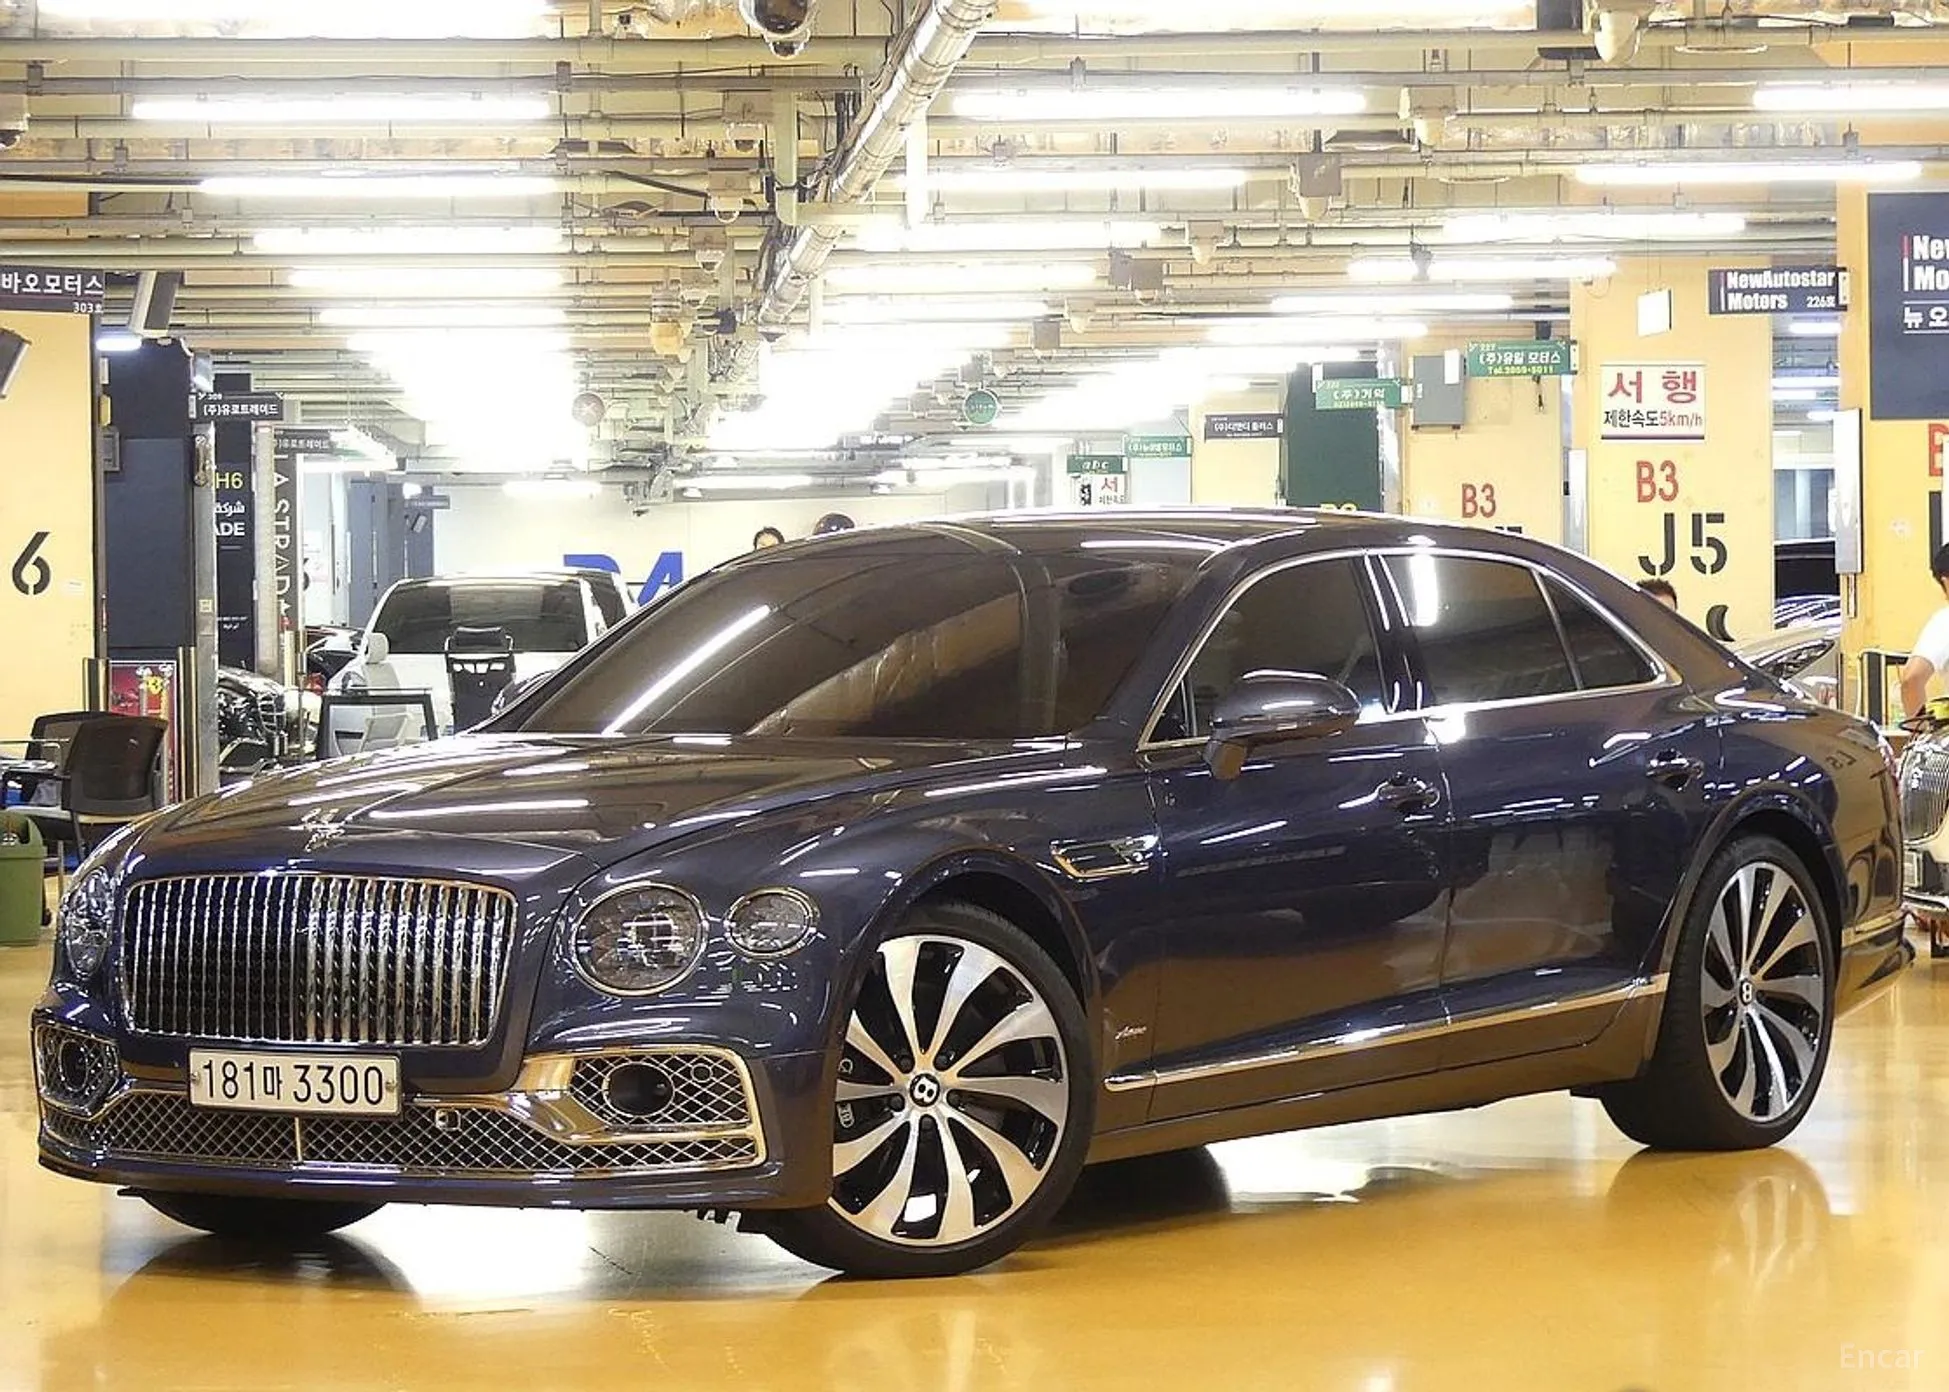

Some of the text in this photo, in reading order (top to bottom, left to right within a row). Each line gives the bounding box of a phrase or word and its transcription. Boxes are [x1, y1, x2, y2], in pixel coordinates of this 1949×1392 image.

[1, 272, 104, 297] 바오모터스
[1727, 270, 1835, 288] NewAutostar
[73, 302, 104, 313] 303호
[1727, 293, 1788, 311] Motors
[1528, 350, 1561, 364] 모터스
[1608, 370, 1697, 404] 서 행
[203, 404, 279, 416] (주)유로트레이드
[1603, 408, 1703, 429] 제한속도5km/h
[1637, 460, 1679, 503] B3
[1461, 483, 1497, 518] B3
[1638, 512, 1728, 577] J5
[12, 531, 51, 596] 6
[203, 1059, 384, 1105] 181마 3300
